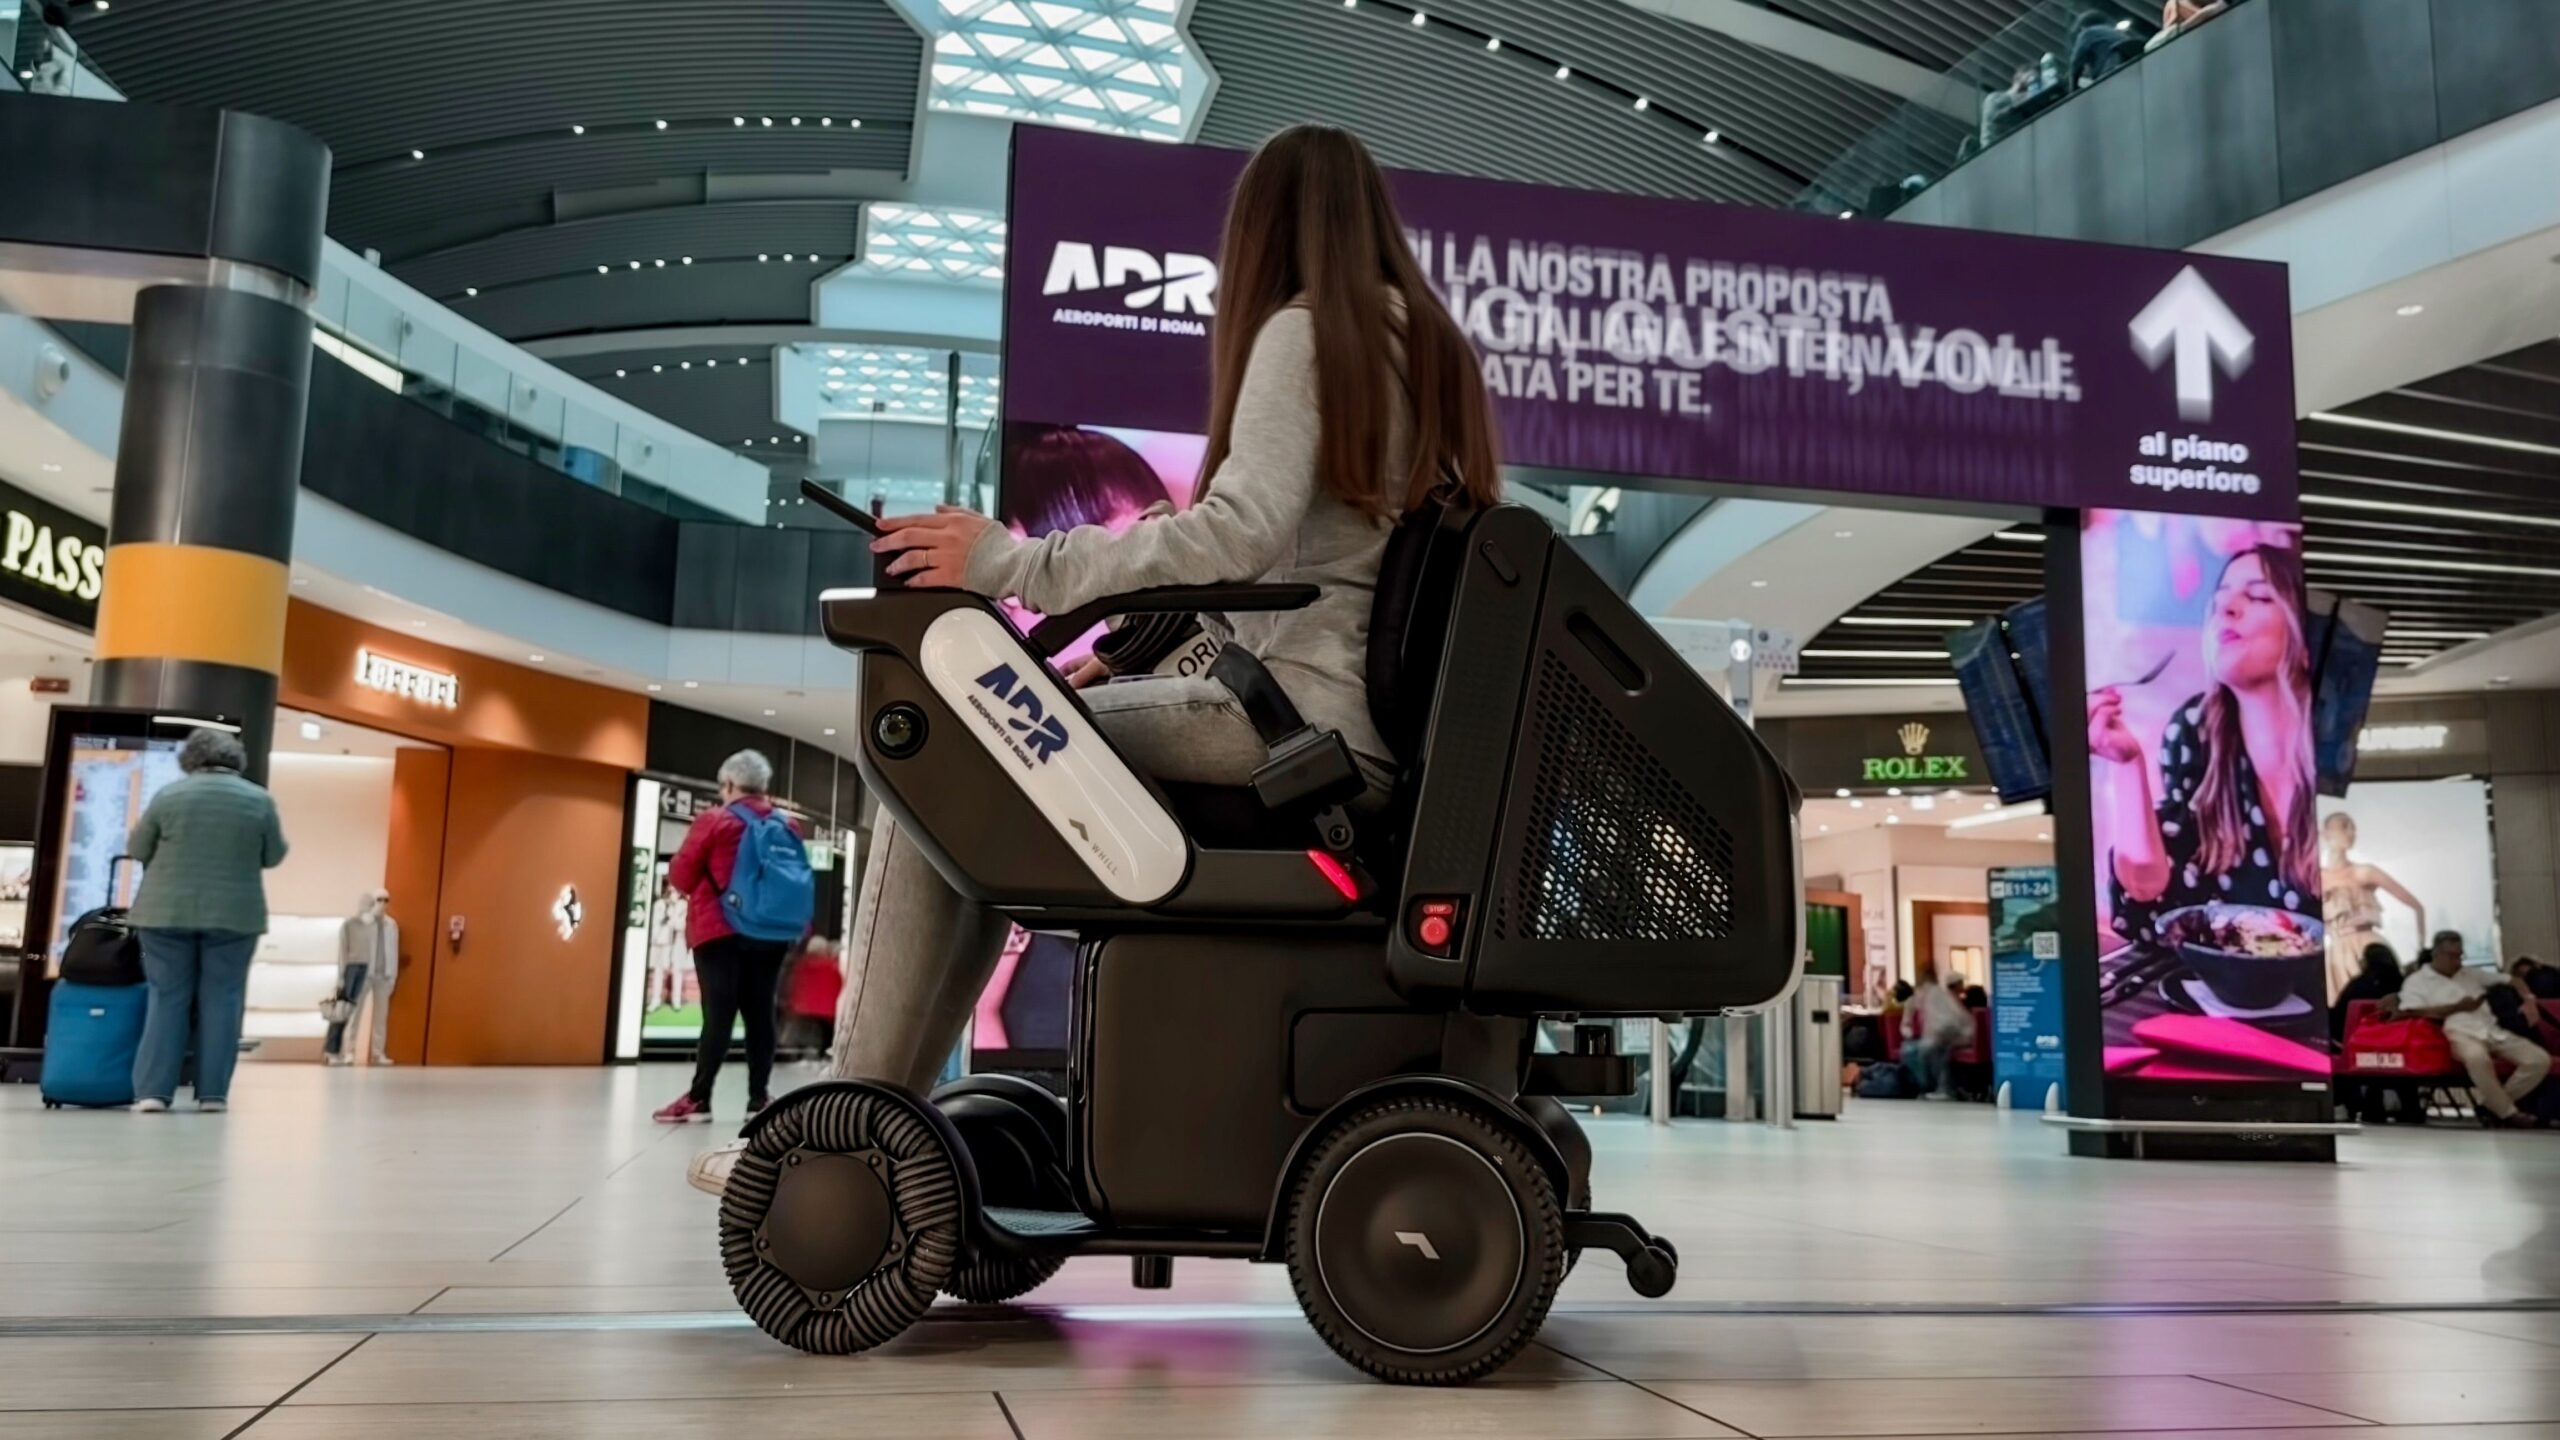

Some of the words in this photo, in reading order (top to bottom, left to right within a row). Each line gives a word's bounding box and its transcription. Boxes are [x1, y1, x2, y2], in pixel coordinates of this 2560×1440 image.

[1042, 240, 1217, 316] ADR
[1444, 234, 1498, 287] LA
[1507, 243, 1677, 303] NOSTRA
[1685, 262, 1894, 325] PROPOSTA
[1052, 308, 1139, 331] AEROPORTI
[1140, 316, 1157, 332] DI
[1159, 318, 1206, 337] ROMA
[1566, 361, 1644, 409] PER
[1651, 369, 1713, 415] TE.
[2138, 430, 2167, 457] al
[2171, 433, 2250, 464] piano
[2129, 464, 2262, 495] superiore
[967, 694, 1006, 738] AEROPORTI
[1003, 734, 1015, 747] DI
[1012, 743, 1035, 771] ROMA
[974, 661, 1069, 765] ADR
[1862, 756, 1968, 780] ROLEX
[1091, 843, 1118, 877] WHILL
